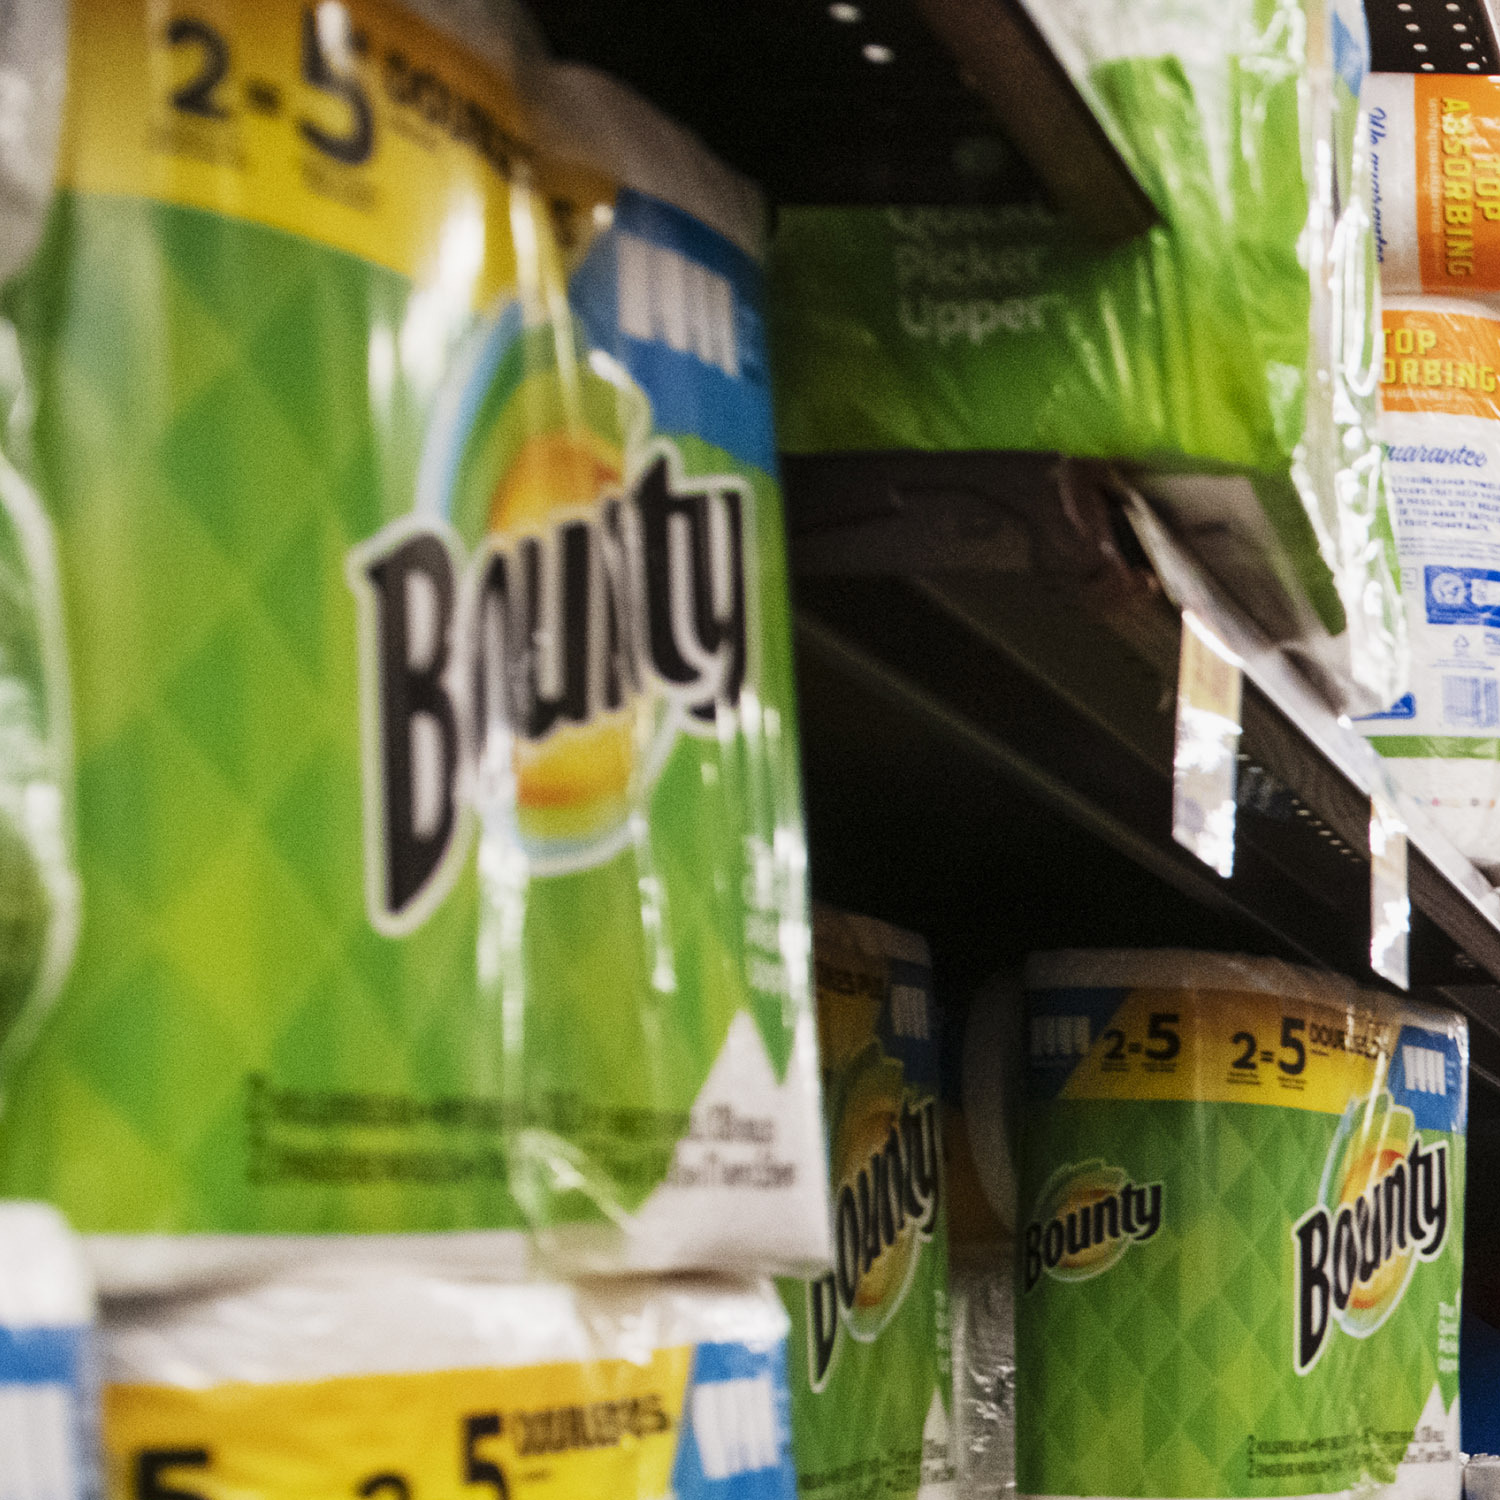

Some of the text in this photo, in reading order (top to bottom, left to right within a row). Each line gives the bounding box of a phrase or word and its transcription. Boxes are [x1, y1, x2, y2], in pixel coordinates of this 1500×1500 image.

[1442, 98, 1474, 277] ABSORBING
[1023, 1181, 1163, 1295] Bounty
[1297, 1138, 1448, 1371] Bounty
